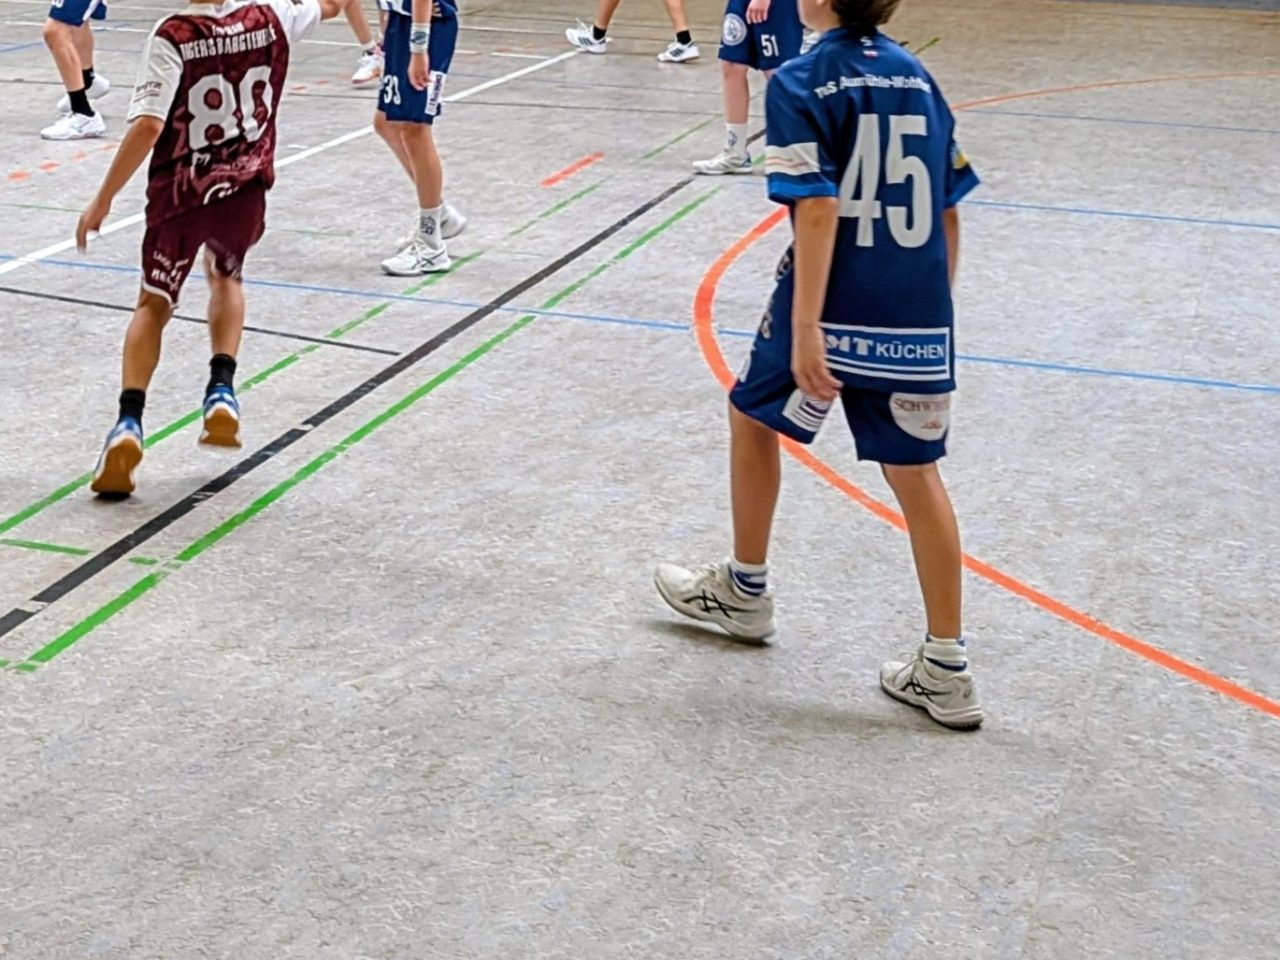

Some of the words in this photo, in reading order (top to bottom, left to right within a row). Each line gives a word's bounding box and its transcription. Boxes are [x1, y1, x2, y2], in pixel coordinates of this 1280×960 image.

[179, 37, 218, 61] TIGERS
[761, 34, 780, 58] 51
[187, 64, 274, 151] 80
[838, 113, 934, 249] 45
[875, 340, 945, 360] KÜCHEN
